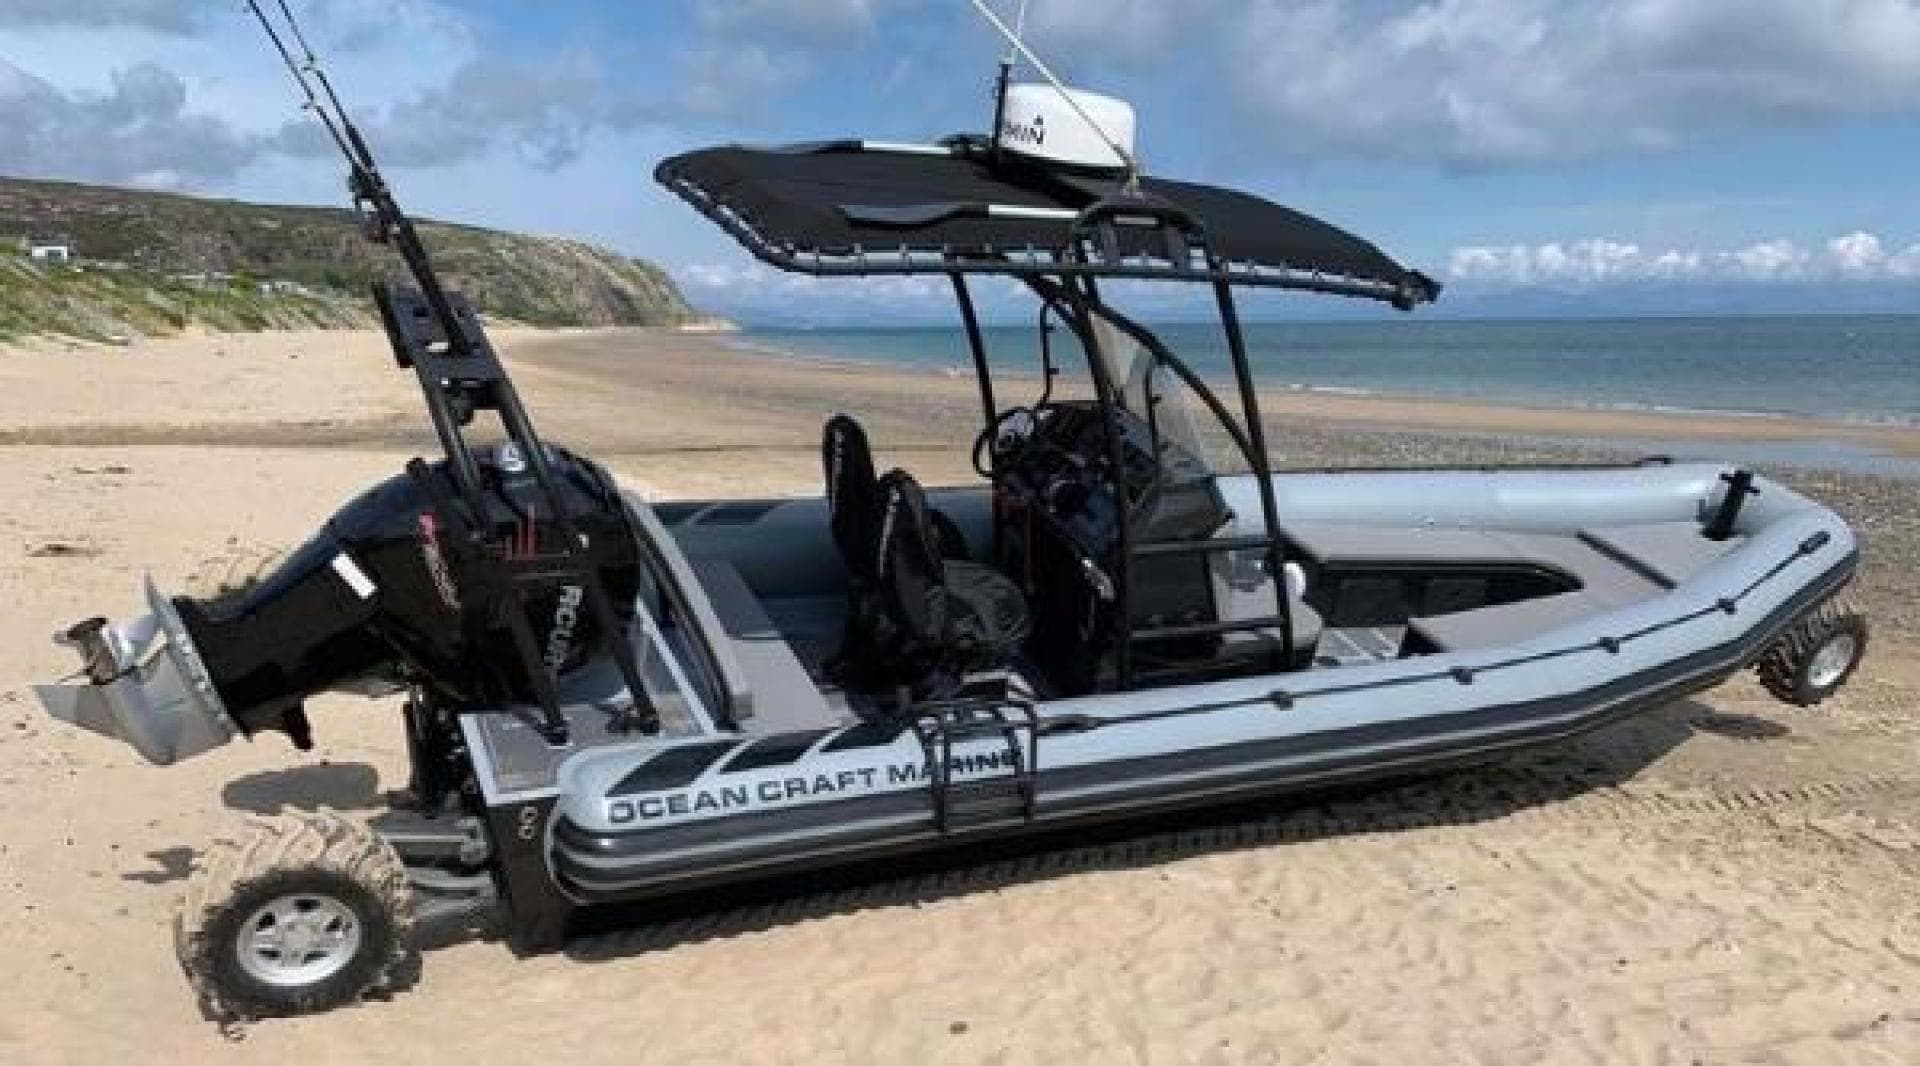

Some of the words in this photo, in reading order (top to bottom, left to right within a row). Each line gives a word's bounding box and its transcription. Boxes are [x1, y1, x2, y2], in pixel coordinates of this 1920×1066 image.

[1004, 119, 1045, 145] MIN
[608, 784, 747, 824] OCEAN
[757, 767, 877, 801] CRAFT
